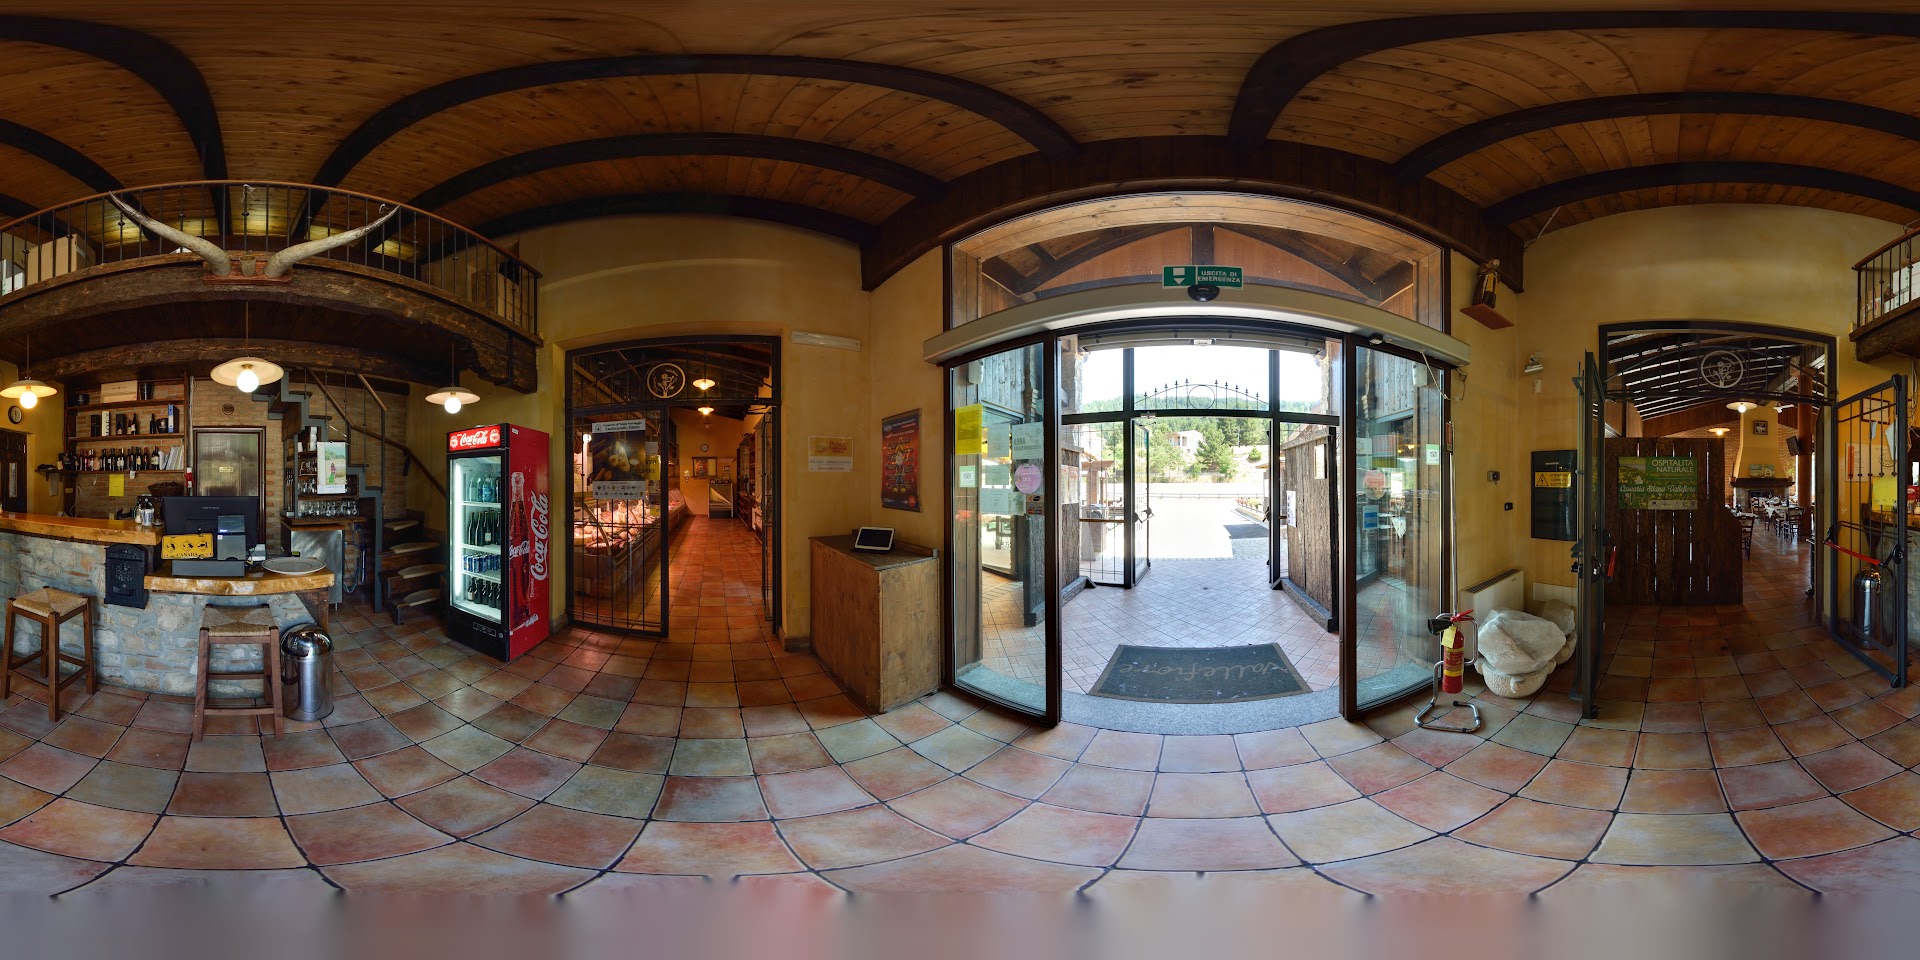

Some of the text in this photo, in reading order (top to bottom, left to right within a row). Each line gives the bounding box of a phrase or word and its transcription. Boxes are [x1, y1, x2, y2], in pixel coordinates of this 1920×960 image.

[1198, 275, 1241, 283] EMERGENZA
[460, 430, 489, 447] Coca-Cola
[530, 490, 549, 582] Coca-Cola
